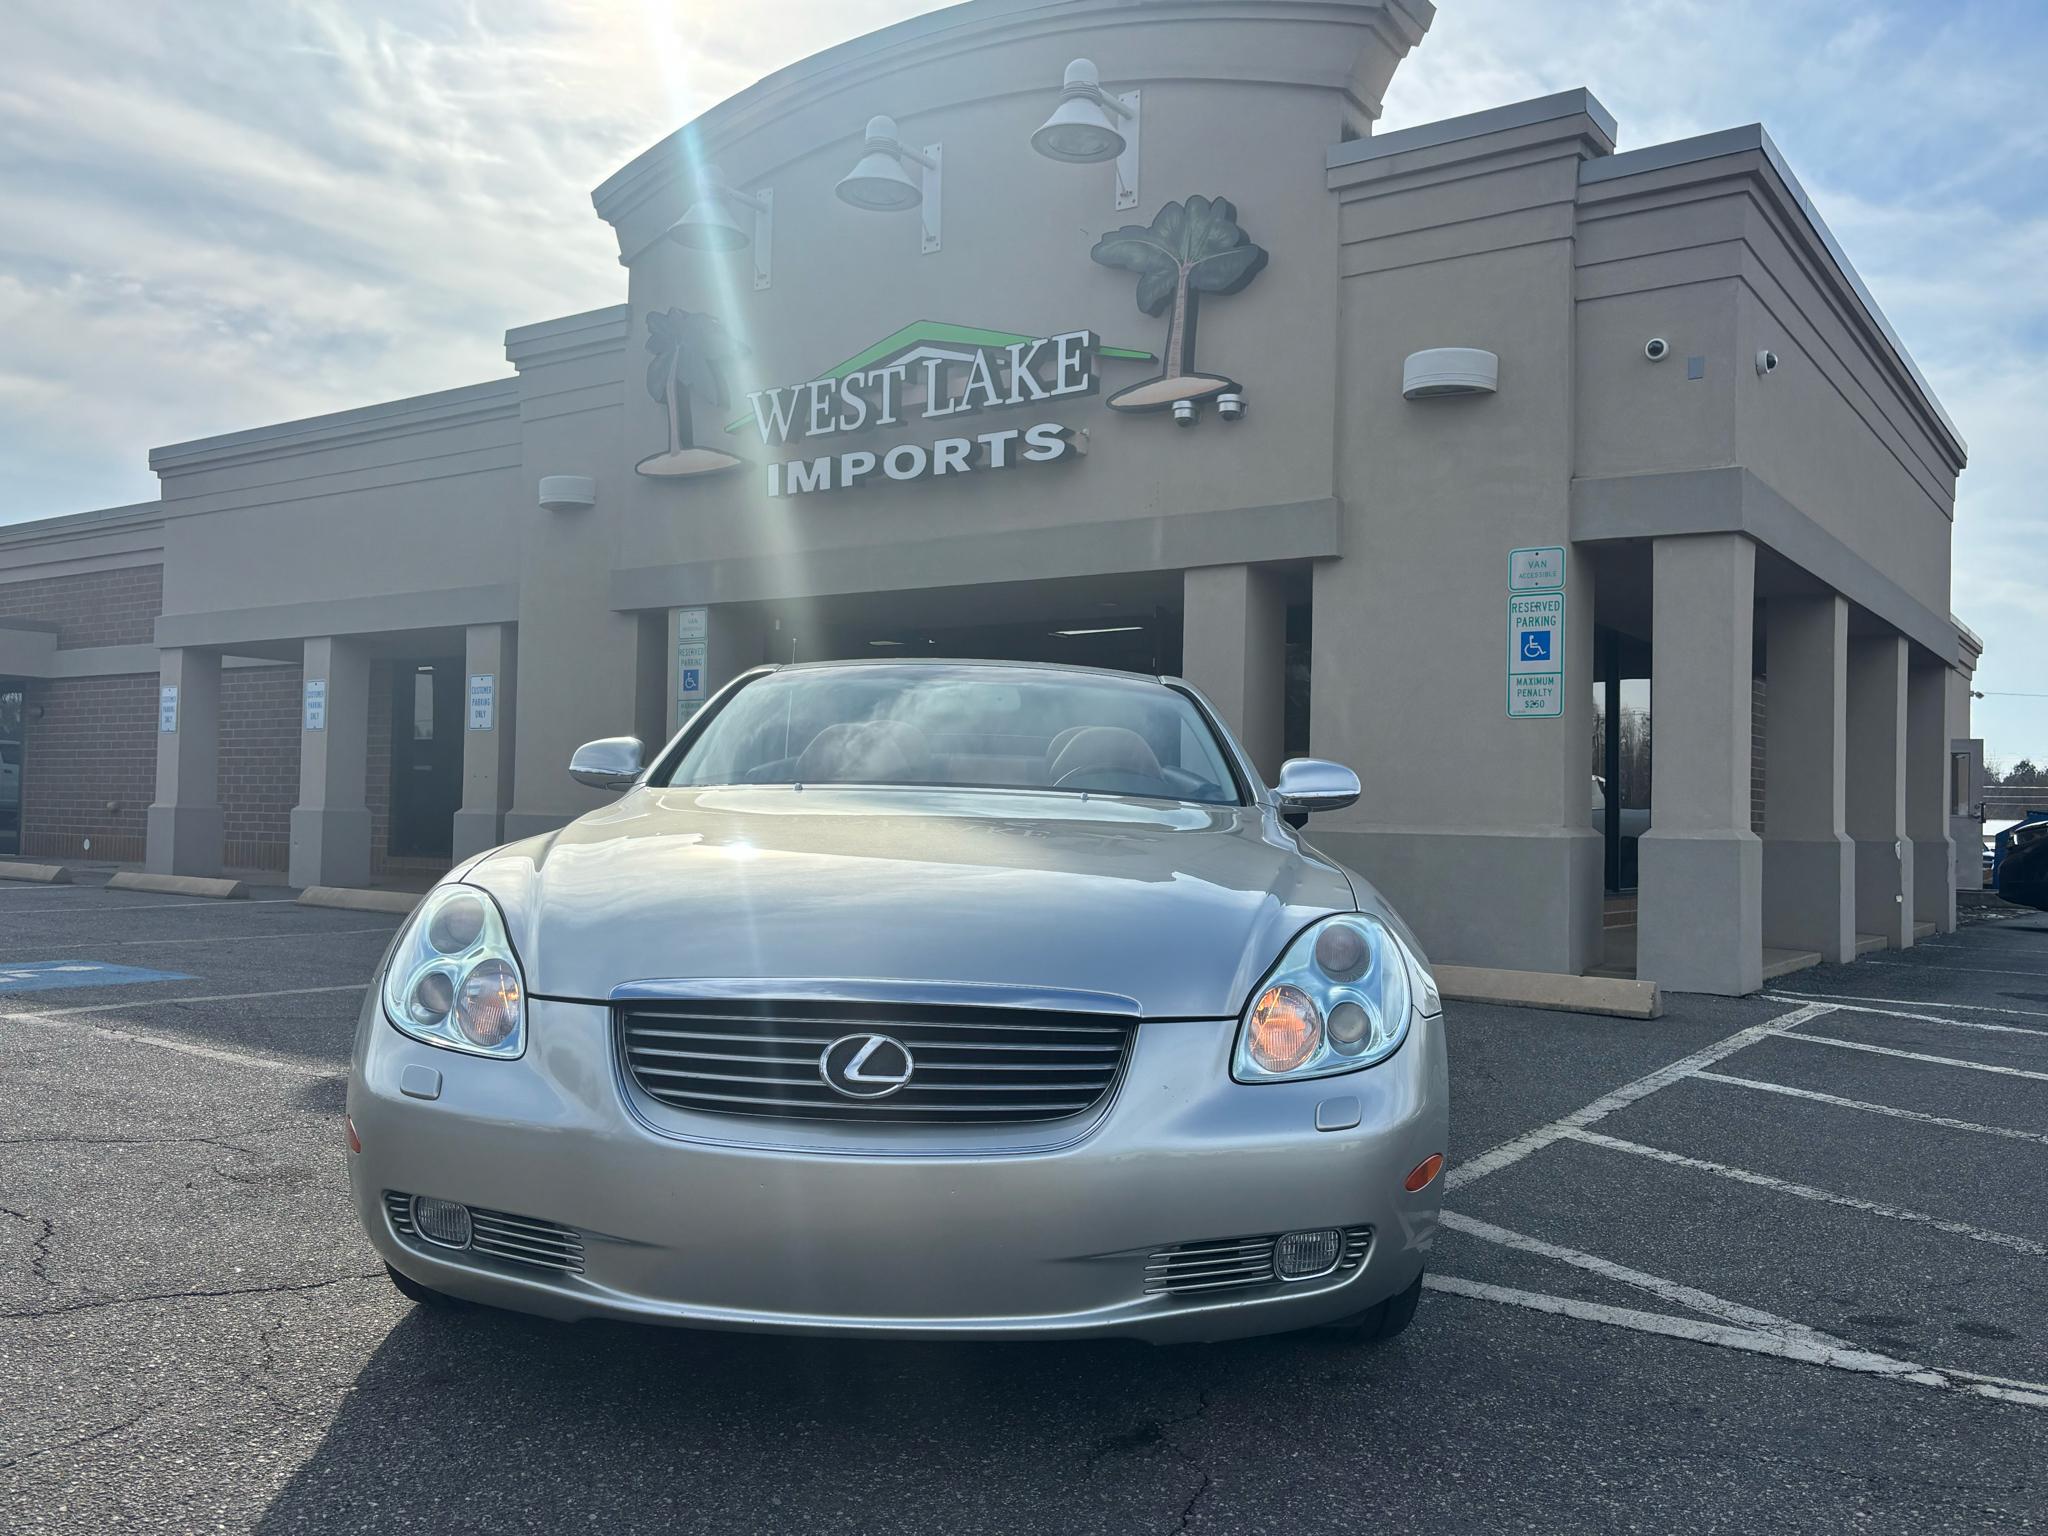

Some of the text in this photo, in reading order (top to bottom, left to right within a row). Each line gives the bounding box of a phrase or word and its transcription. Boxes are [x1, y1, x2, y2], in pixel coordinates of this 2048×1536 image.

[746, 329, 1092, 444] WEST LAKE
[767, 423, 1068, 497] IMPORTS
[1528, 560, 1547, 568] VAN
[1519, 571, 1557, 579] ACCESSIBLE
[1511, 601, 1560, 613] RESERVED
[1516, 615, 1557, 628] PARKING
[1516, 677, 1554, 687] MAXIMUM
[472, 686, 492, 694] CUSTOMER
[1517, 688, 1553, 698] PENALTY
[472, 698, 490, 706] PARKING
[475, 710, 486, 719] ONLY
